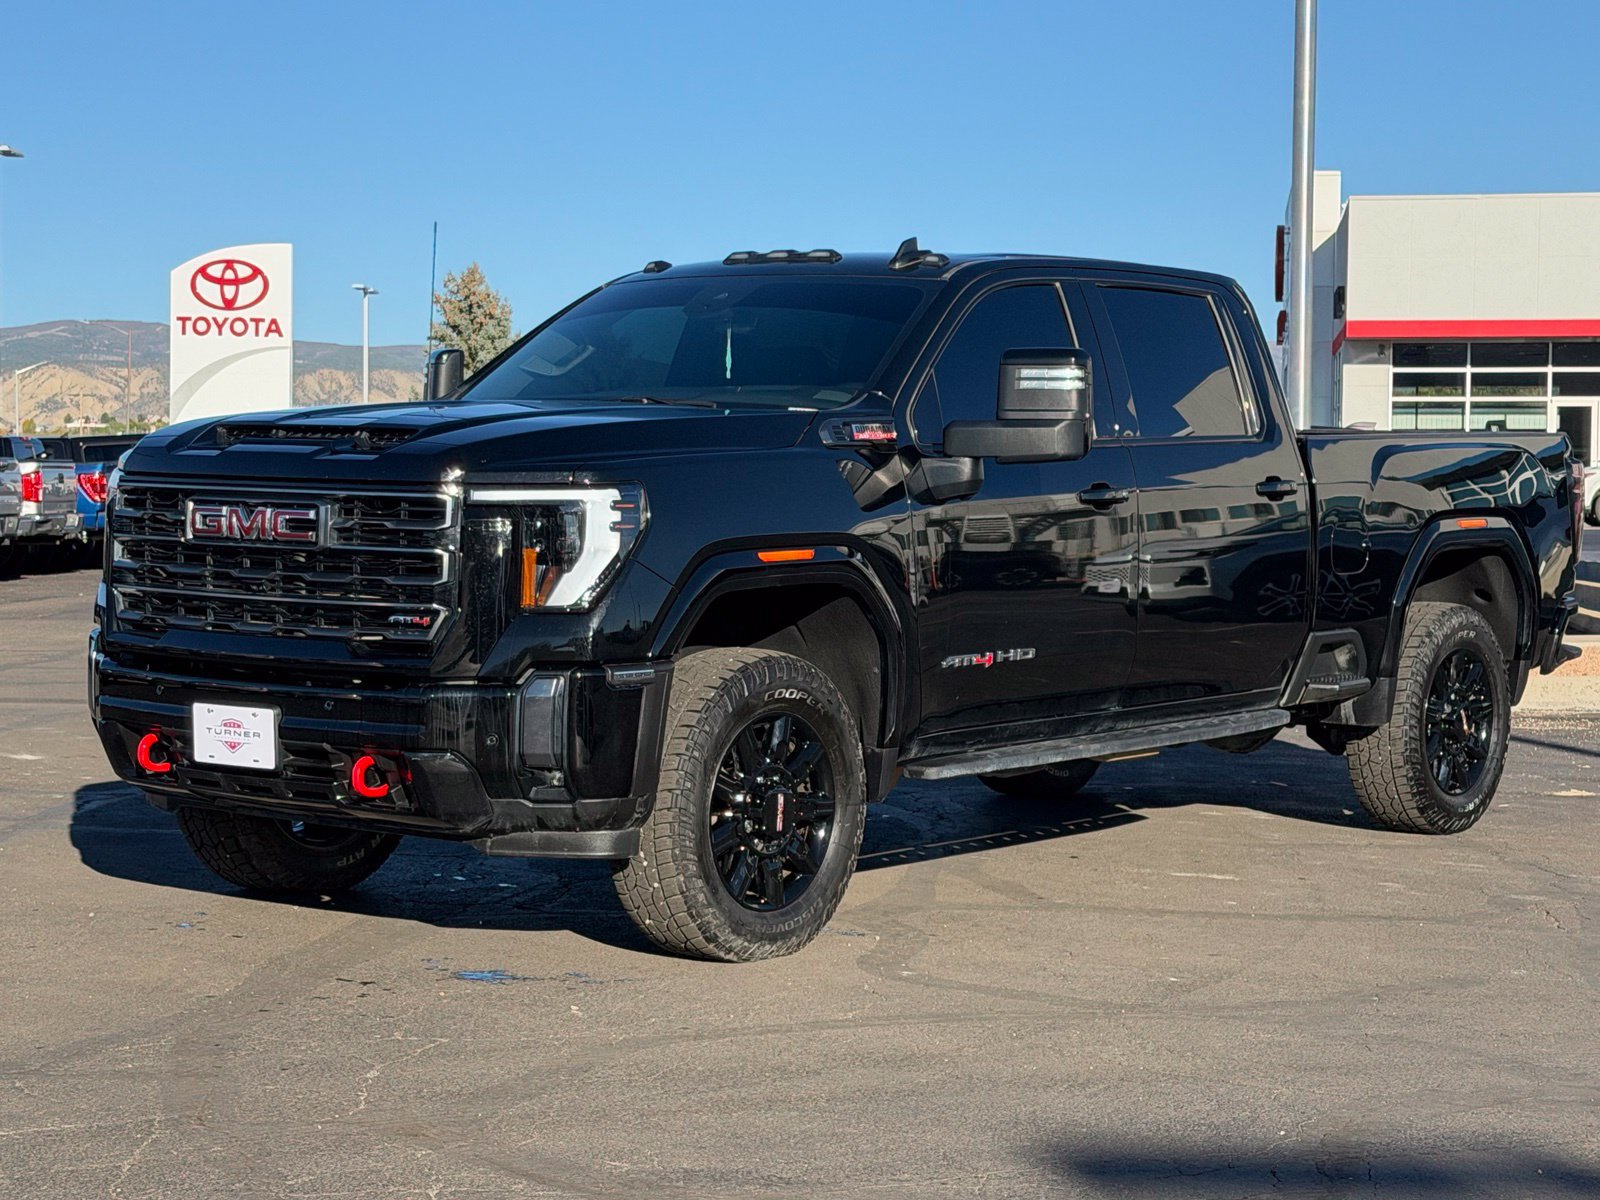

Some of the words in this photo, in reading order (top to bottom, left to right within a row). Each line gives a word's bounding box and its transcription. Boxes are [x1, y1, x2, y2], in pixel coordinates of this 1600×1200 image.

[176, 316, 284, 338] TOYOTA
[191, 504, 317, 541] GMC
[941, 652, 993, 668] AT4
[997, 648, 1036, 662] HD
[764, 688, 826, 716] COOPER
[206, 727, 261, 739] TURNER
